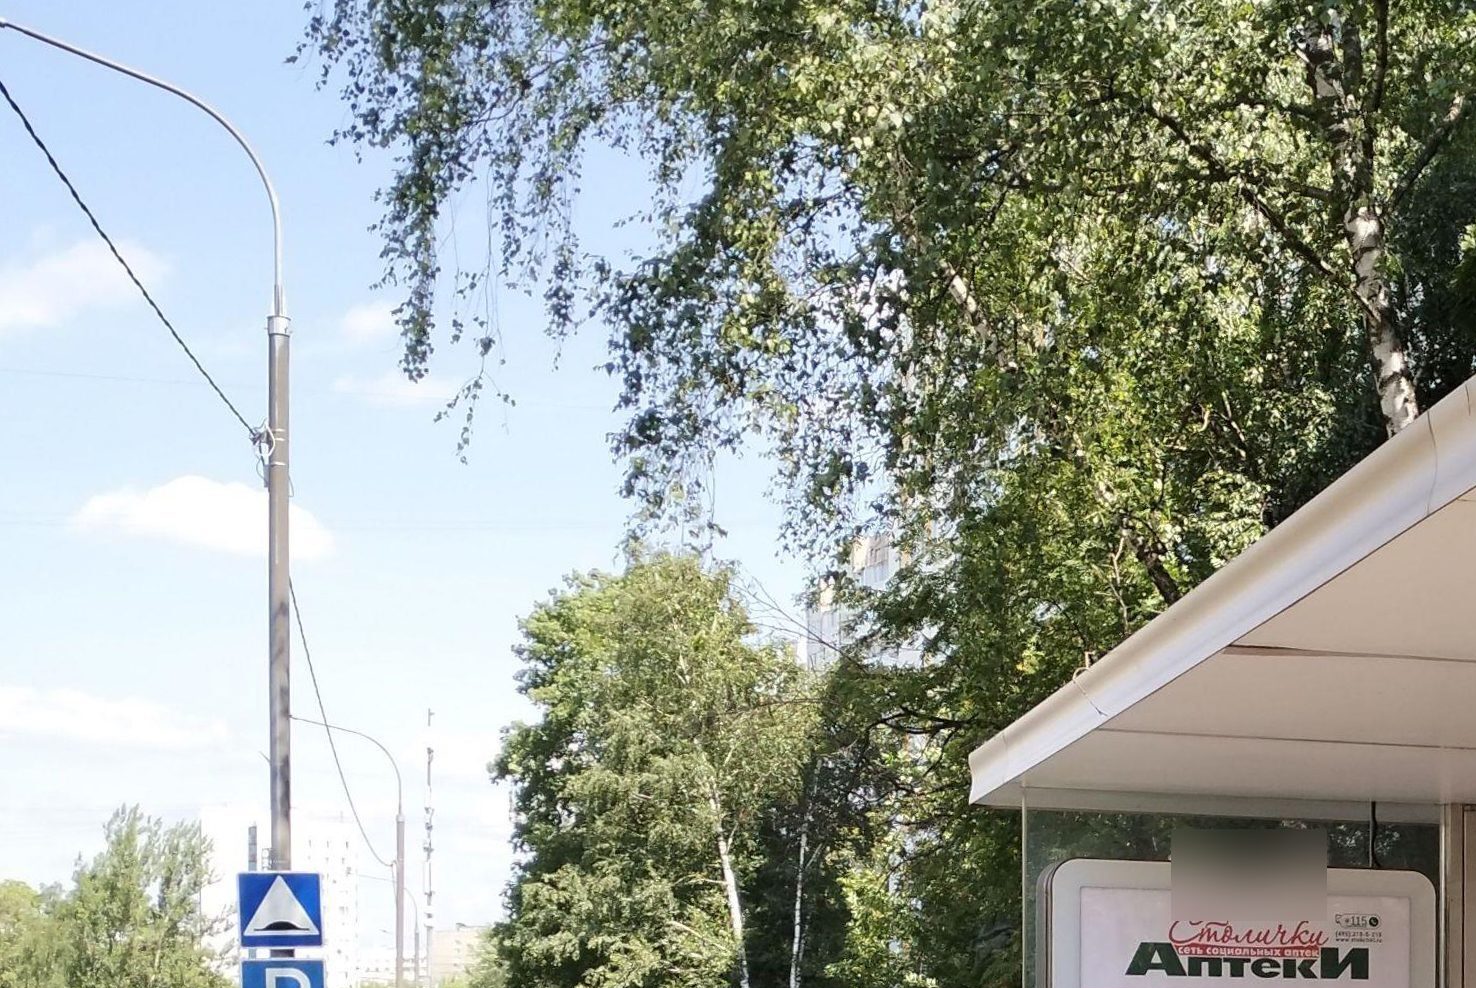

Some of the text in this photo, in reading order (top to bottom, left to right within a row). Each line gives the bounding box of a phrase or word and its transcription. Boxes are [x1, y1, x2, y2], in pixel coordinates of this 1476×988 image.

[1168, 920, 1329, 946] Столички
[1178, 946, 1319, 957] сеть социальных аптек
